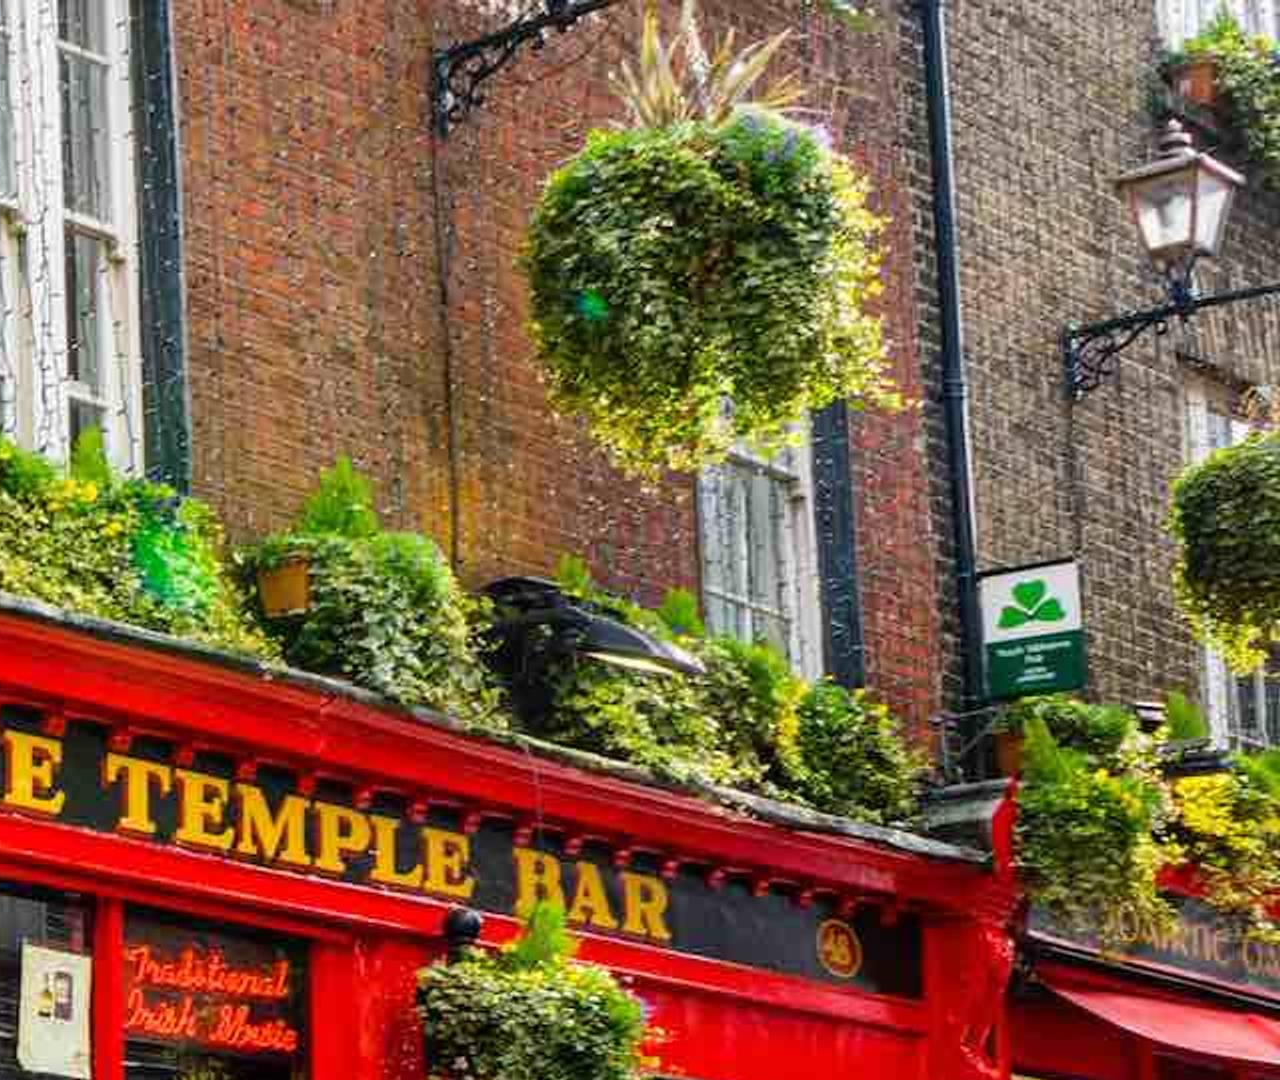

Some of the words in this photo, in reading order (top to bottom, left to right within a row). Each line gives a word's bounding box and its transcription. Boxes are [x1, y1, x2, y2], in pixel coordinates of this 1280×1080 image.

[104, 752, 475, 899] TEMPLE
[512, 846, 674, 943] BAR
[125, 943, 290, 999] Traditional
[125, 989, 197, 1037] Irish
[214, 1005, 300, 1053] Music
